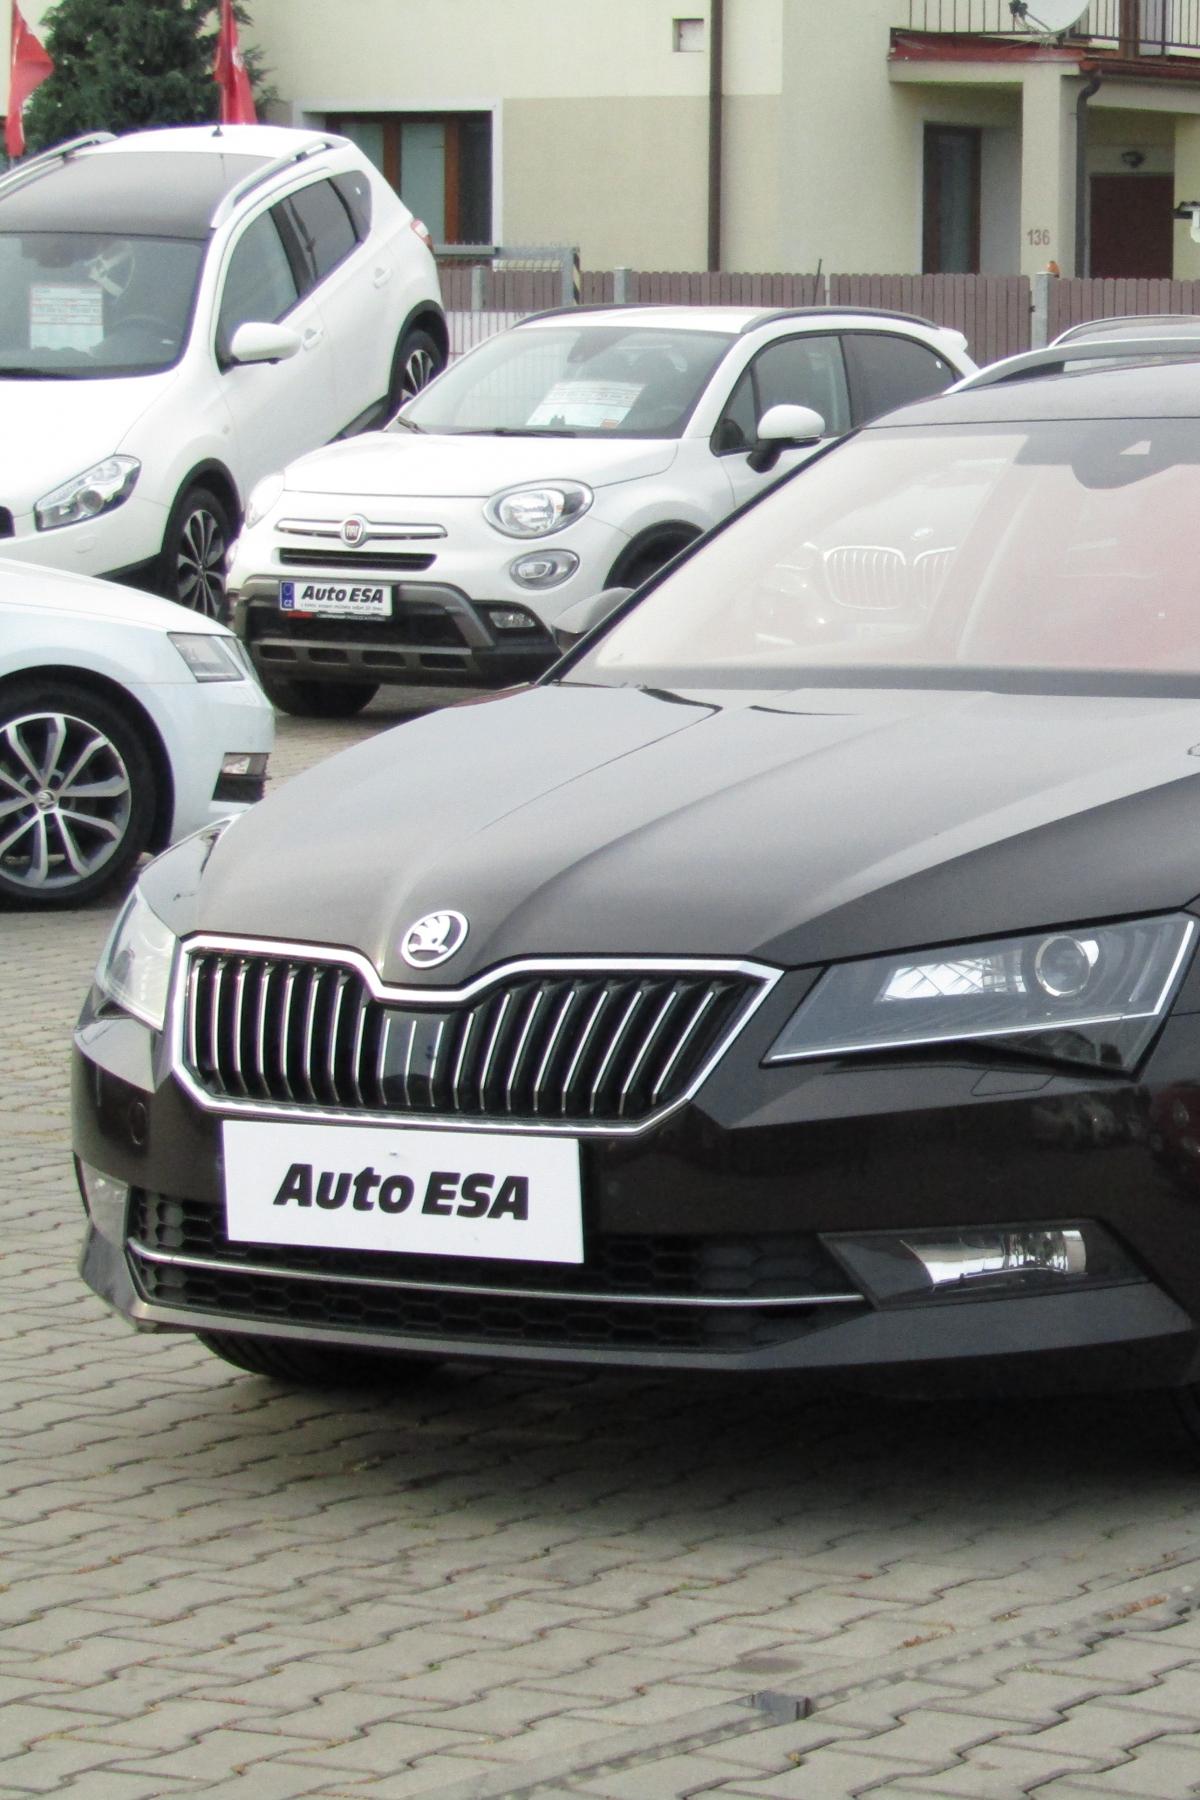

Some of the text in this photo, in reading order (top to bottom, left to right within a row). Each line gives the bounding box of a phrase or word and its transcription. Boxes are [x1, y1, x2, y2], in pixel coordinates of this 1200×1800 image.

[1027, 229, 1050, 246] 136
[301, 585, 384, 604] Auto ESA
[273, 1163, 529, 1221] Auto ESA
